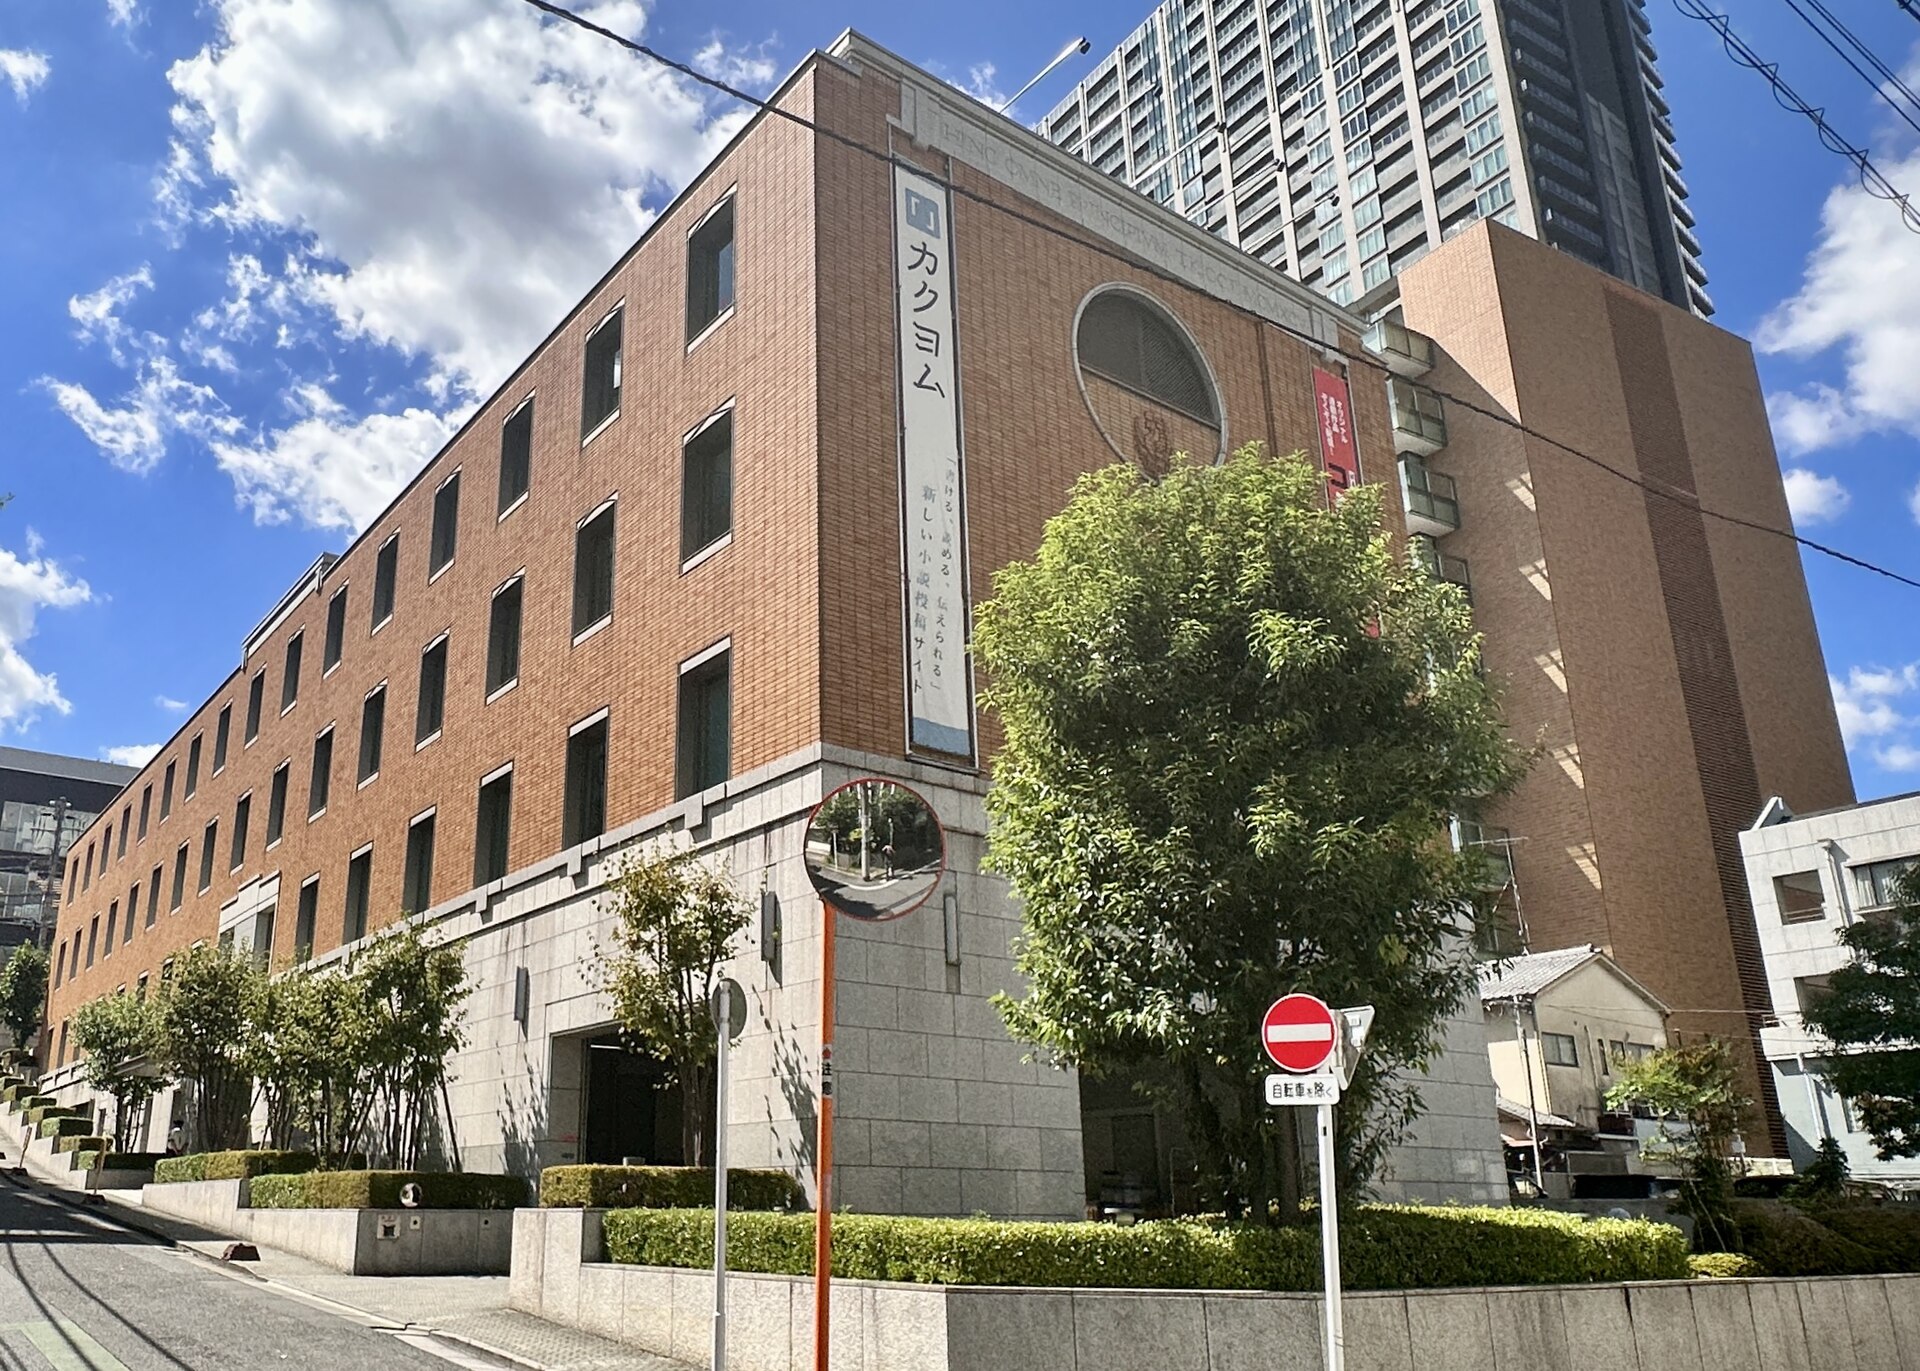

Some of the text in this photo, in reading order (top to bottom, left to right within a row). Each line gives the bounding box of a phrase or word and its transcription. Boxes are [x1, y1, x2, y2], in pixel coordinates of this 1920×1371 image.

[907, 241, 946, 399] カクヨム
[1272, 1082, 1332, 1099] 自転車を除く
